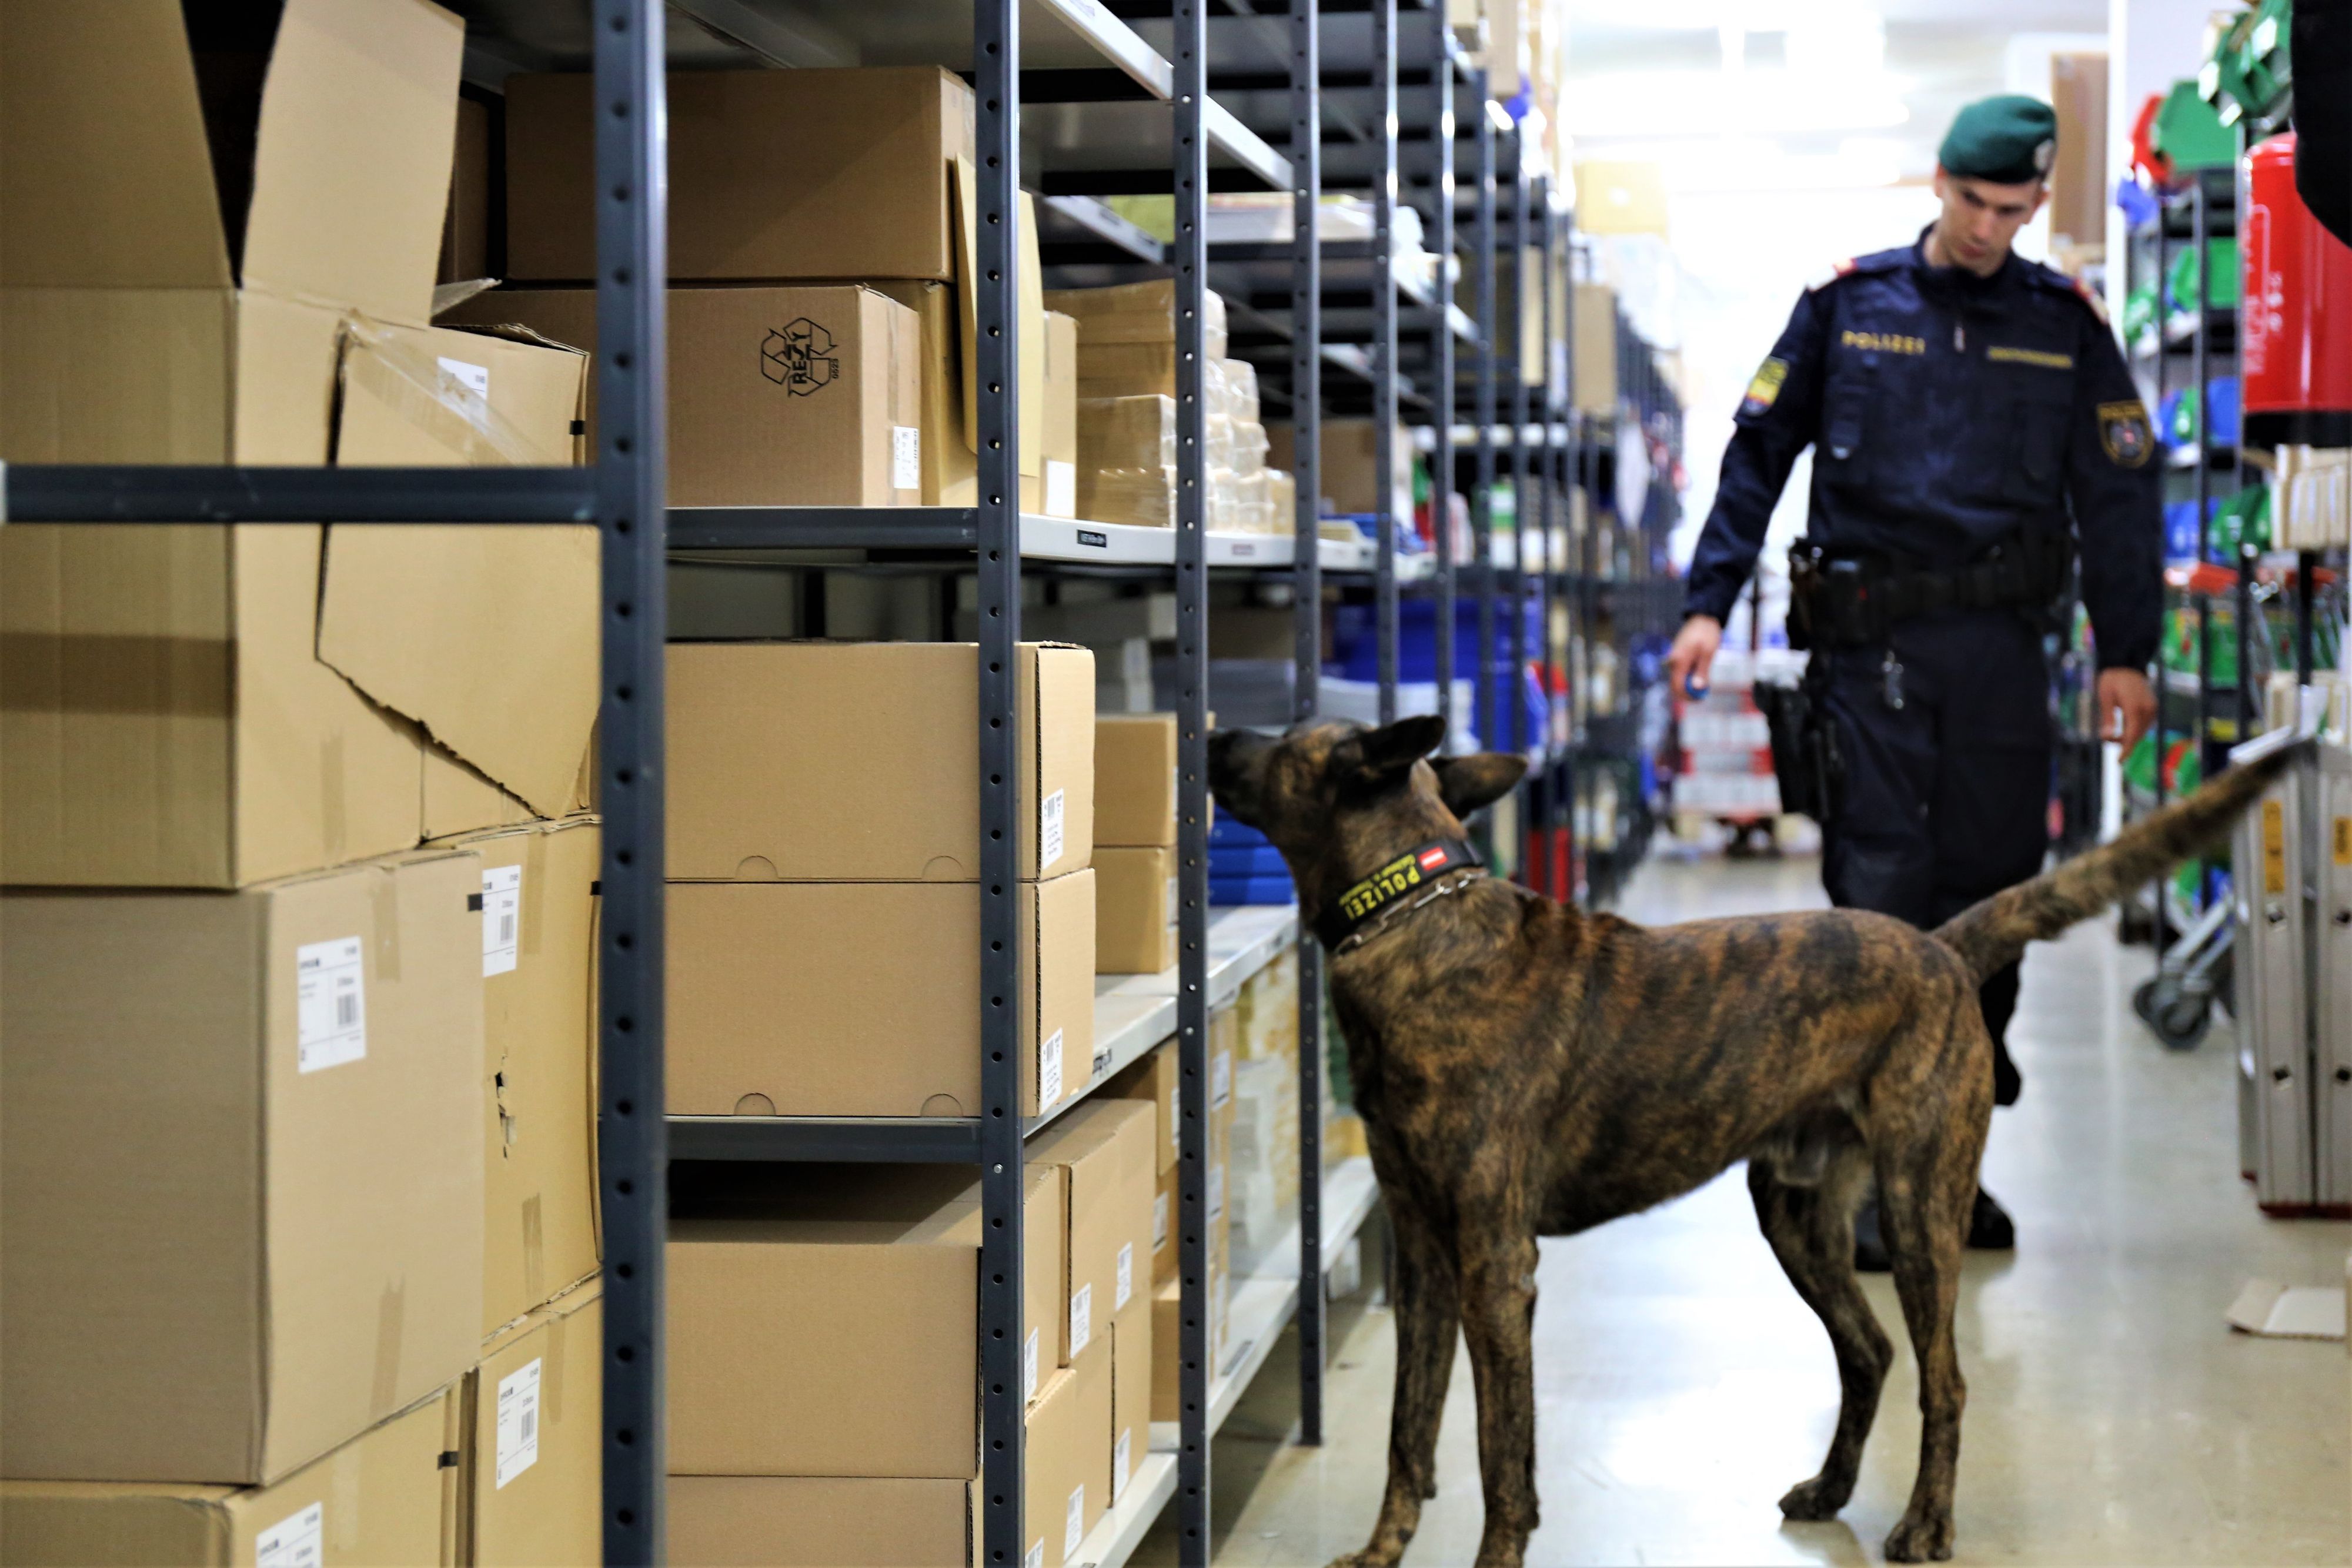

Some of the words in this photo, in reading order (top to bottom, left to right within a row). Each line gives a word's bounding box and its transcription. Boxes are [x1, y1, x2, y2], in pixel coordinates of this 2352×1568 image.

[787, 332, 811, 384] RESY
[1841, 330, 1925, 355] POLIZEI
[1345, 865, 1421, 920] POLIZEI
